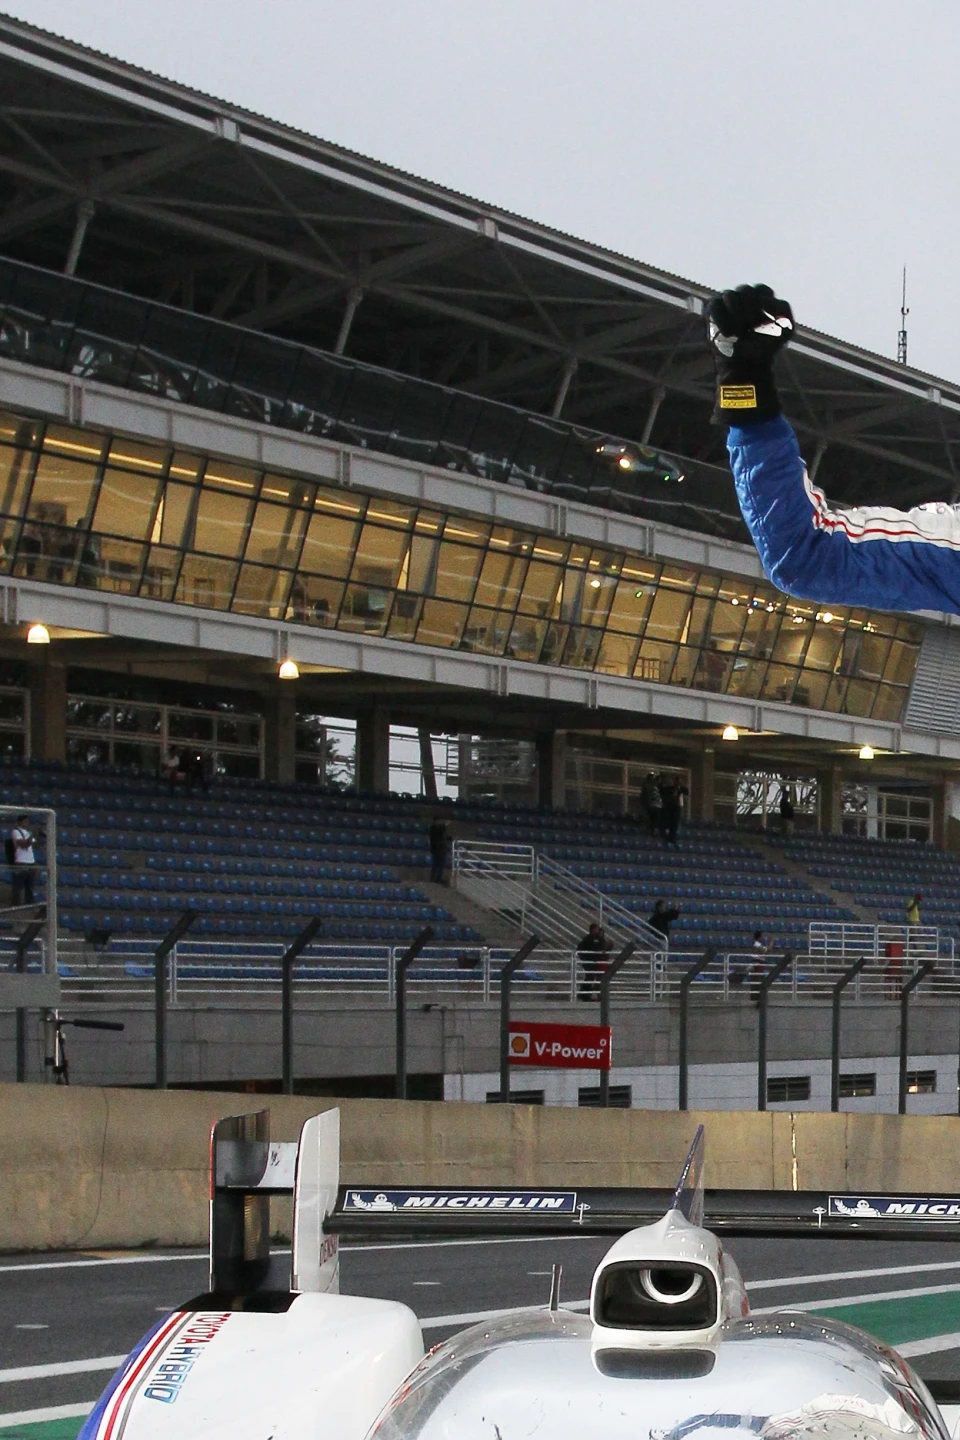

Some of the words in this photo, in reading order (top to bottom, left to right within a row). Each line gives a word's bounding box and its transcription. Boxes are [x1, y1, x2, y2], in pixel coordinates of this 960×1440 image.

[534, 1041, 604, 1059] V-Power
[403, 1195, 565, 1209] MICHELIN
[176, 1313, 232, 1345] TOYOTA
[143, 1346, 206, 1404] HYBRID
